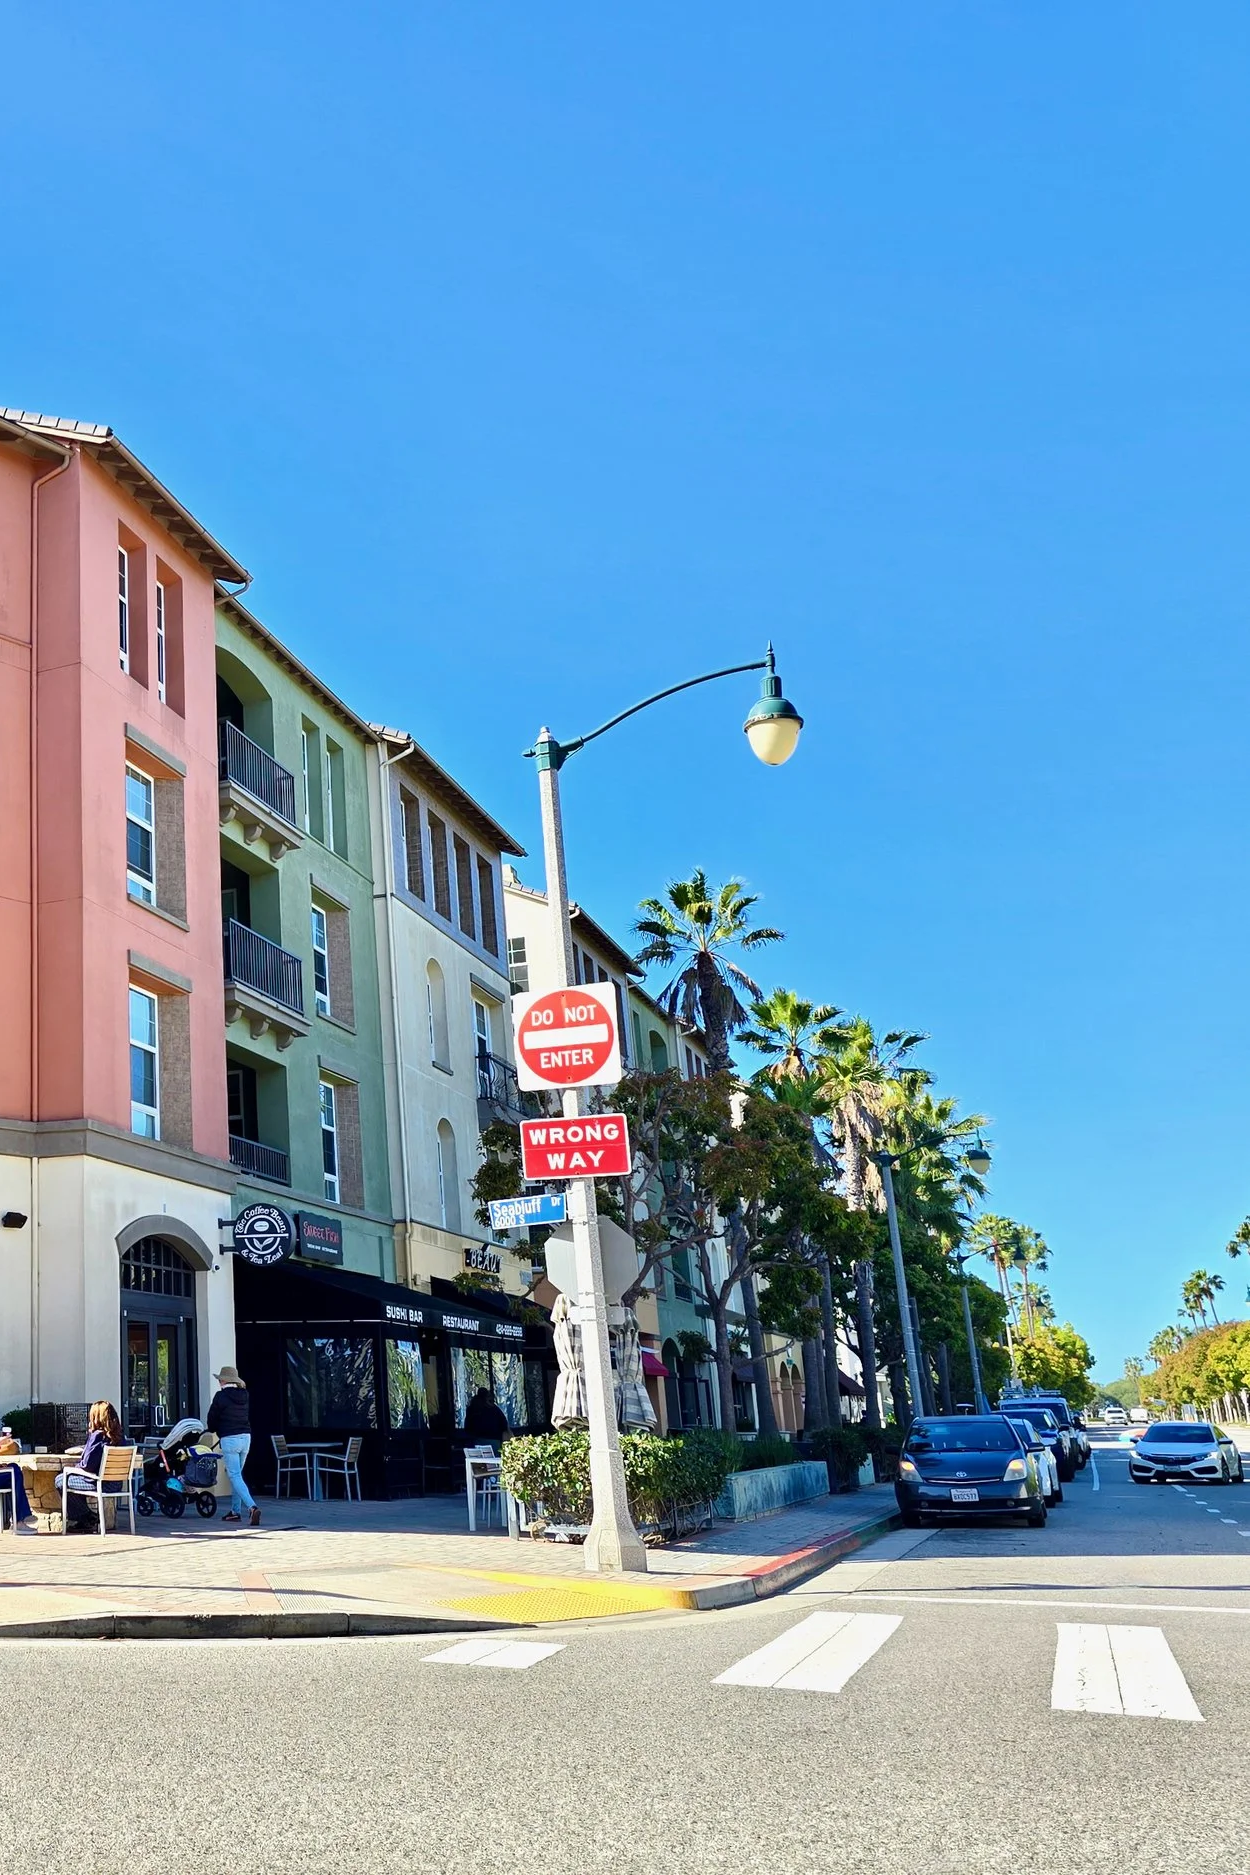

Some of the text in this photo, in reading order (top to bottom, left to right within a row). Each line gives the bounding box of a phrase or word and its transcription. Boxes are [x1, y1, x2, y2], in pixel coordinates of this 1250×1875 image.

[531, 1004, 597, 1026] DO NOT
[539, 1049, 594, 1069] ENTER
[528, 1123, 620, 1146] WRONG
[546, 1150, 605, 1170] WAY
[493, 1196, 561, 1217] Seabluff Dr
[244, 1205, 270, 1220] Coffee
[270, 1208, 287, 1234] Bean
[494, 1215, 525, 1228] 6000 S
[241, 1245, 284, 1265] & Tea Leaf
[386, 1305, 424, 1323] SUSHI BAR
[442, 1315, 480, 1332] RESTAURANT
